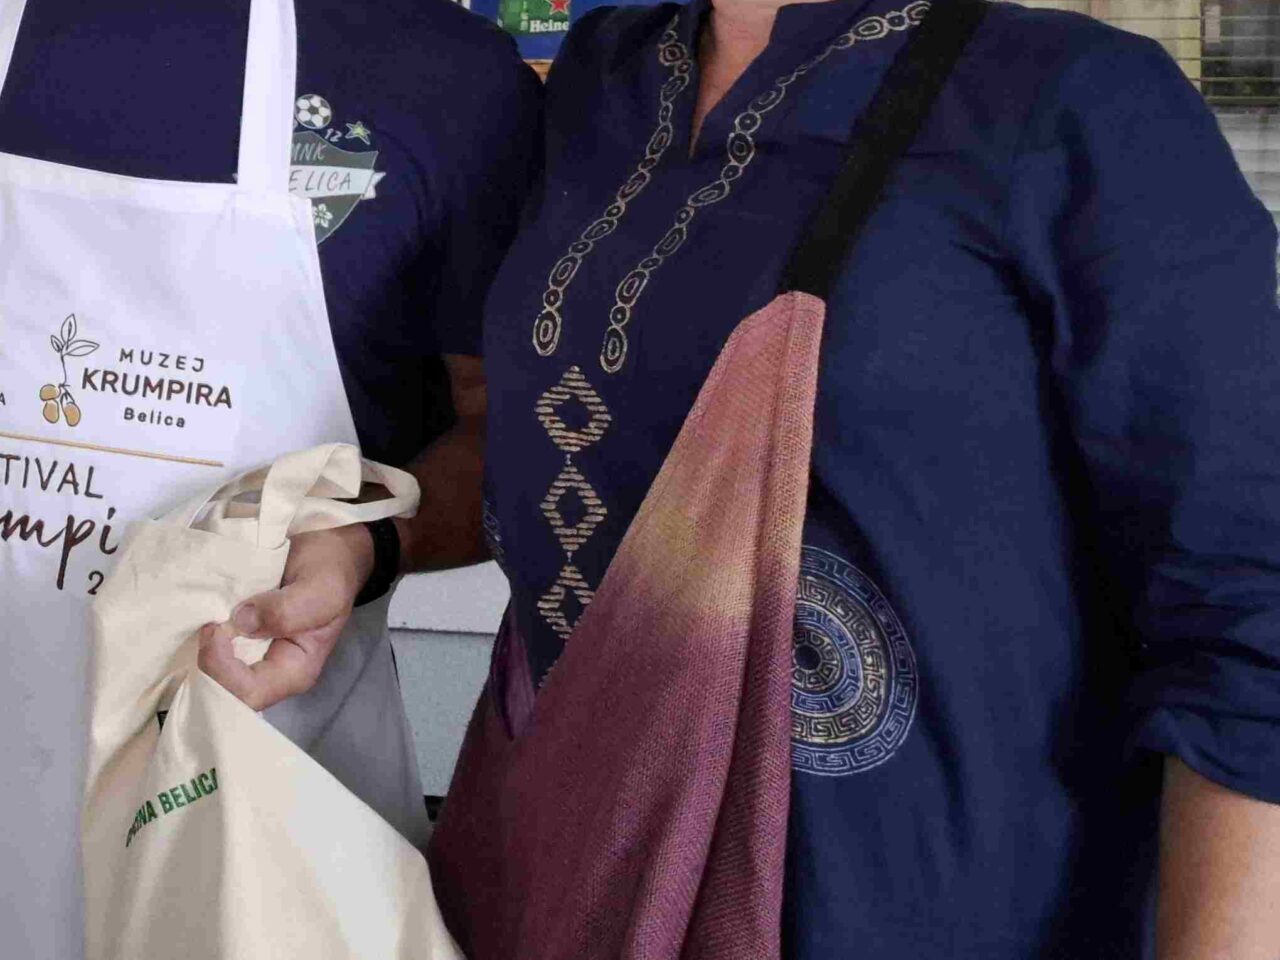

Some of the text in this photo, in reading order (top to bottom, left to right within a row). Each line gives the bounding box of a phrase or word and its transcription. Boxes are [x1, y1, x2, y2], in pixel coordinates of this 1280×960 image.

[324, 128, 343, 142] 12
[119, 347, 205, 372] MUZEJ
[81, 368, 232, 409] KRUMPIRA
[123, 407, 186, 429] Belica
